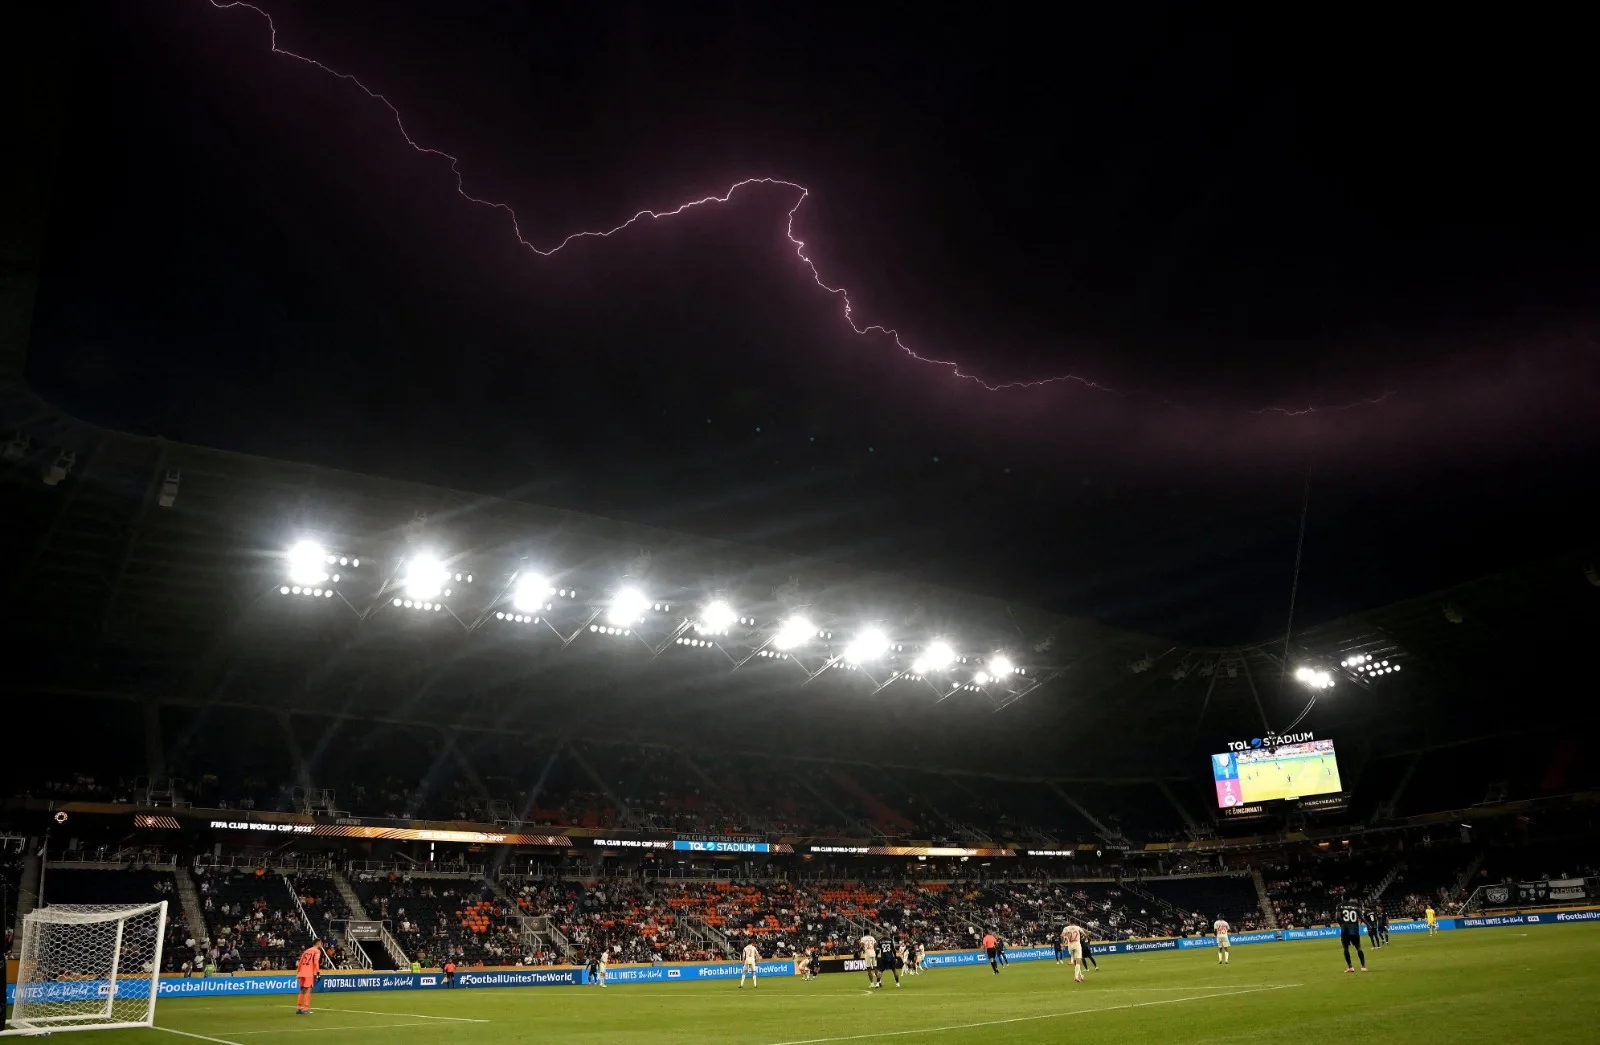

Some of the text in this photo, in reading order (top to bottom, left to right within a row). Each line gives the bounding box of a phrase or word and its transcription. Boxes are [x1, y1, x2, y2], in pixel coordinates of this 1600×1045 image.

[1228, 732, 1313, 751] TQL STADIUM
[1225, 782, 1231, 792] 2
[1233, 806, 1262, 815] CINCINNATI
[210, 821, 228, 829] FIFA
[249, 823, 277, 831] WORLD
[688, 842, 755, 852] TQL STADIUM
[1342, 910, 1357, 923] 30
[1370, 914, 1375, 922] 8
[1068, 931, 1079, 943] 22
[881, 943, 891, 953] 23
[619, 970, 637, 979] UNITES
[323, 978, 357, 988] FOOTBALL
[357, 977, 381, 987] UNITES
[382, 977, 394, 986] the
[394, 976, 414, 987] World
